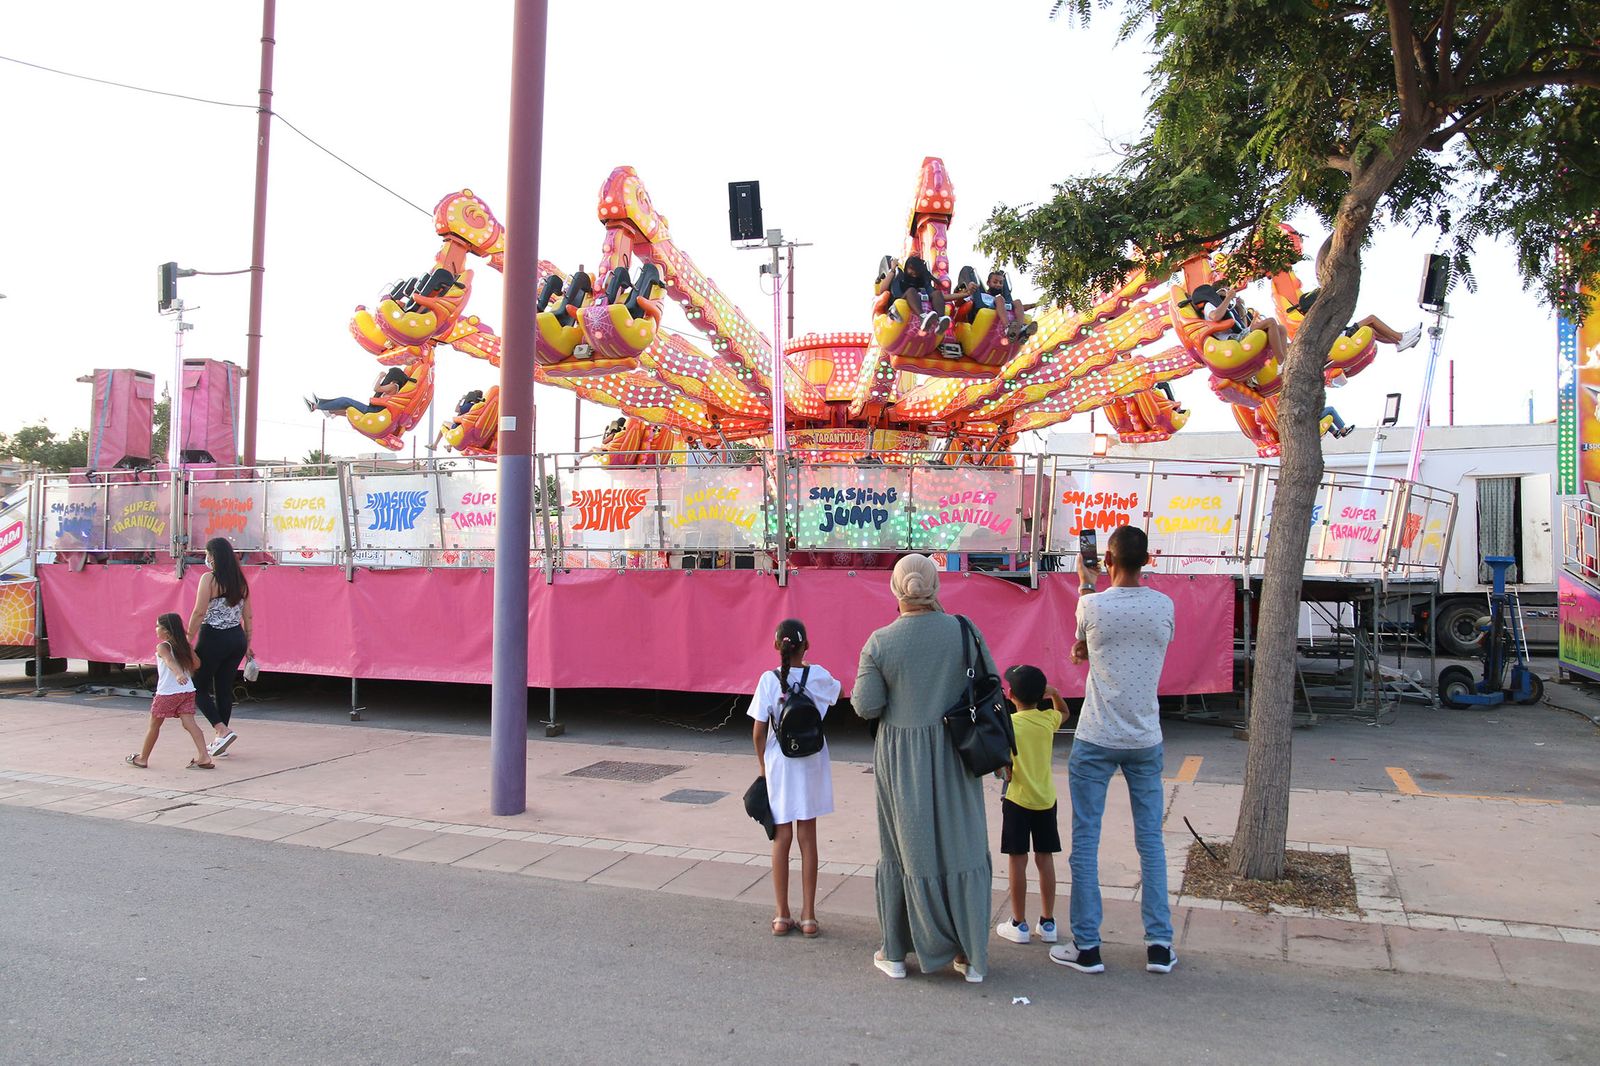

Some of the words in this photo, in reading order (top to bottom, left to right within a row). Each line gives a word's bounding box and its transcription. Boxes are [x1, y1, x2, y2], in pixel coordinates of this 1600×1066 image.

[814, 432, 861, 444] TARANTULA
[282, 496, 326, 511] SUPER
[364, 490, 430, 509] SMASHING
[461, 492, 496, 505] SUPE
[568, 488, 650, 507] SMASHING
[685, 487, 741, 506] SUPER
[938, 490, 999, 509] SUPER
[1168, 495, 1222, 511] SUPER
[123, 500, 157, 515] SUPER
[1340, 506, 1376, 521] SUPER
[112, 515, 165, 536] TARANTULA
[272, 515, 336, 533] TARANTULA
[368, 507, 425, 532] JUMP
[571, 505, 646, 532] JUMP
[668, 504, 758, 531] TARANTULA
[919, 508, 1013, 536] TARANTULA
[1154, 516, 1233, 537] TARANTULA
[1329, 523, 1381, 545] TARANTULA
